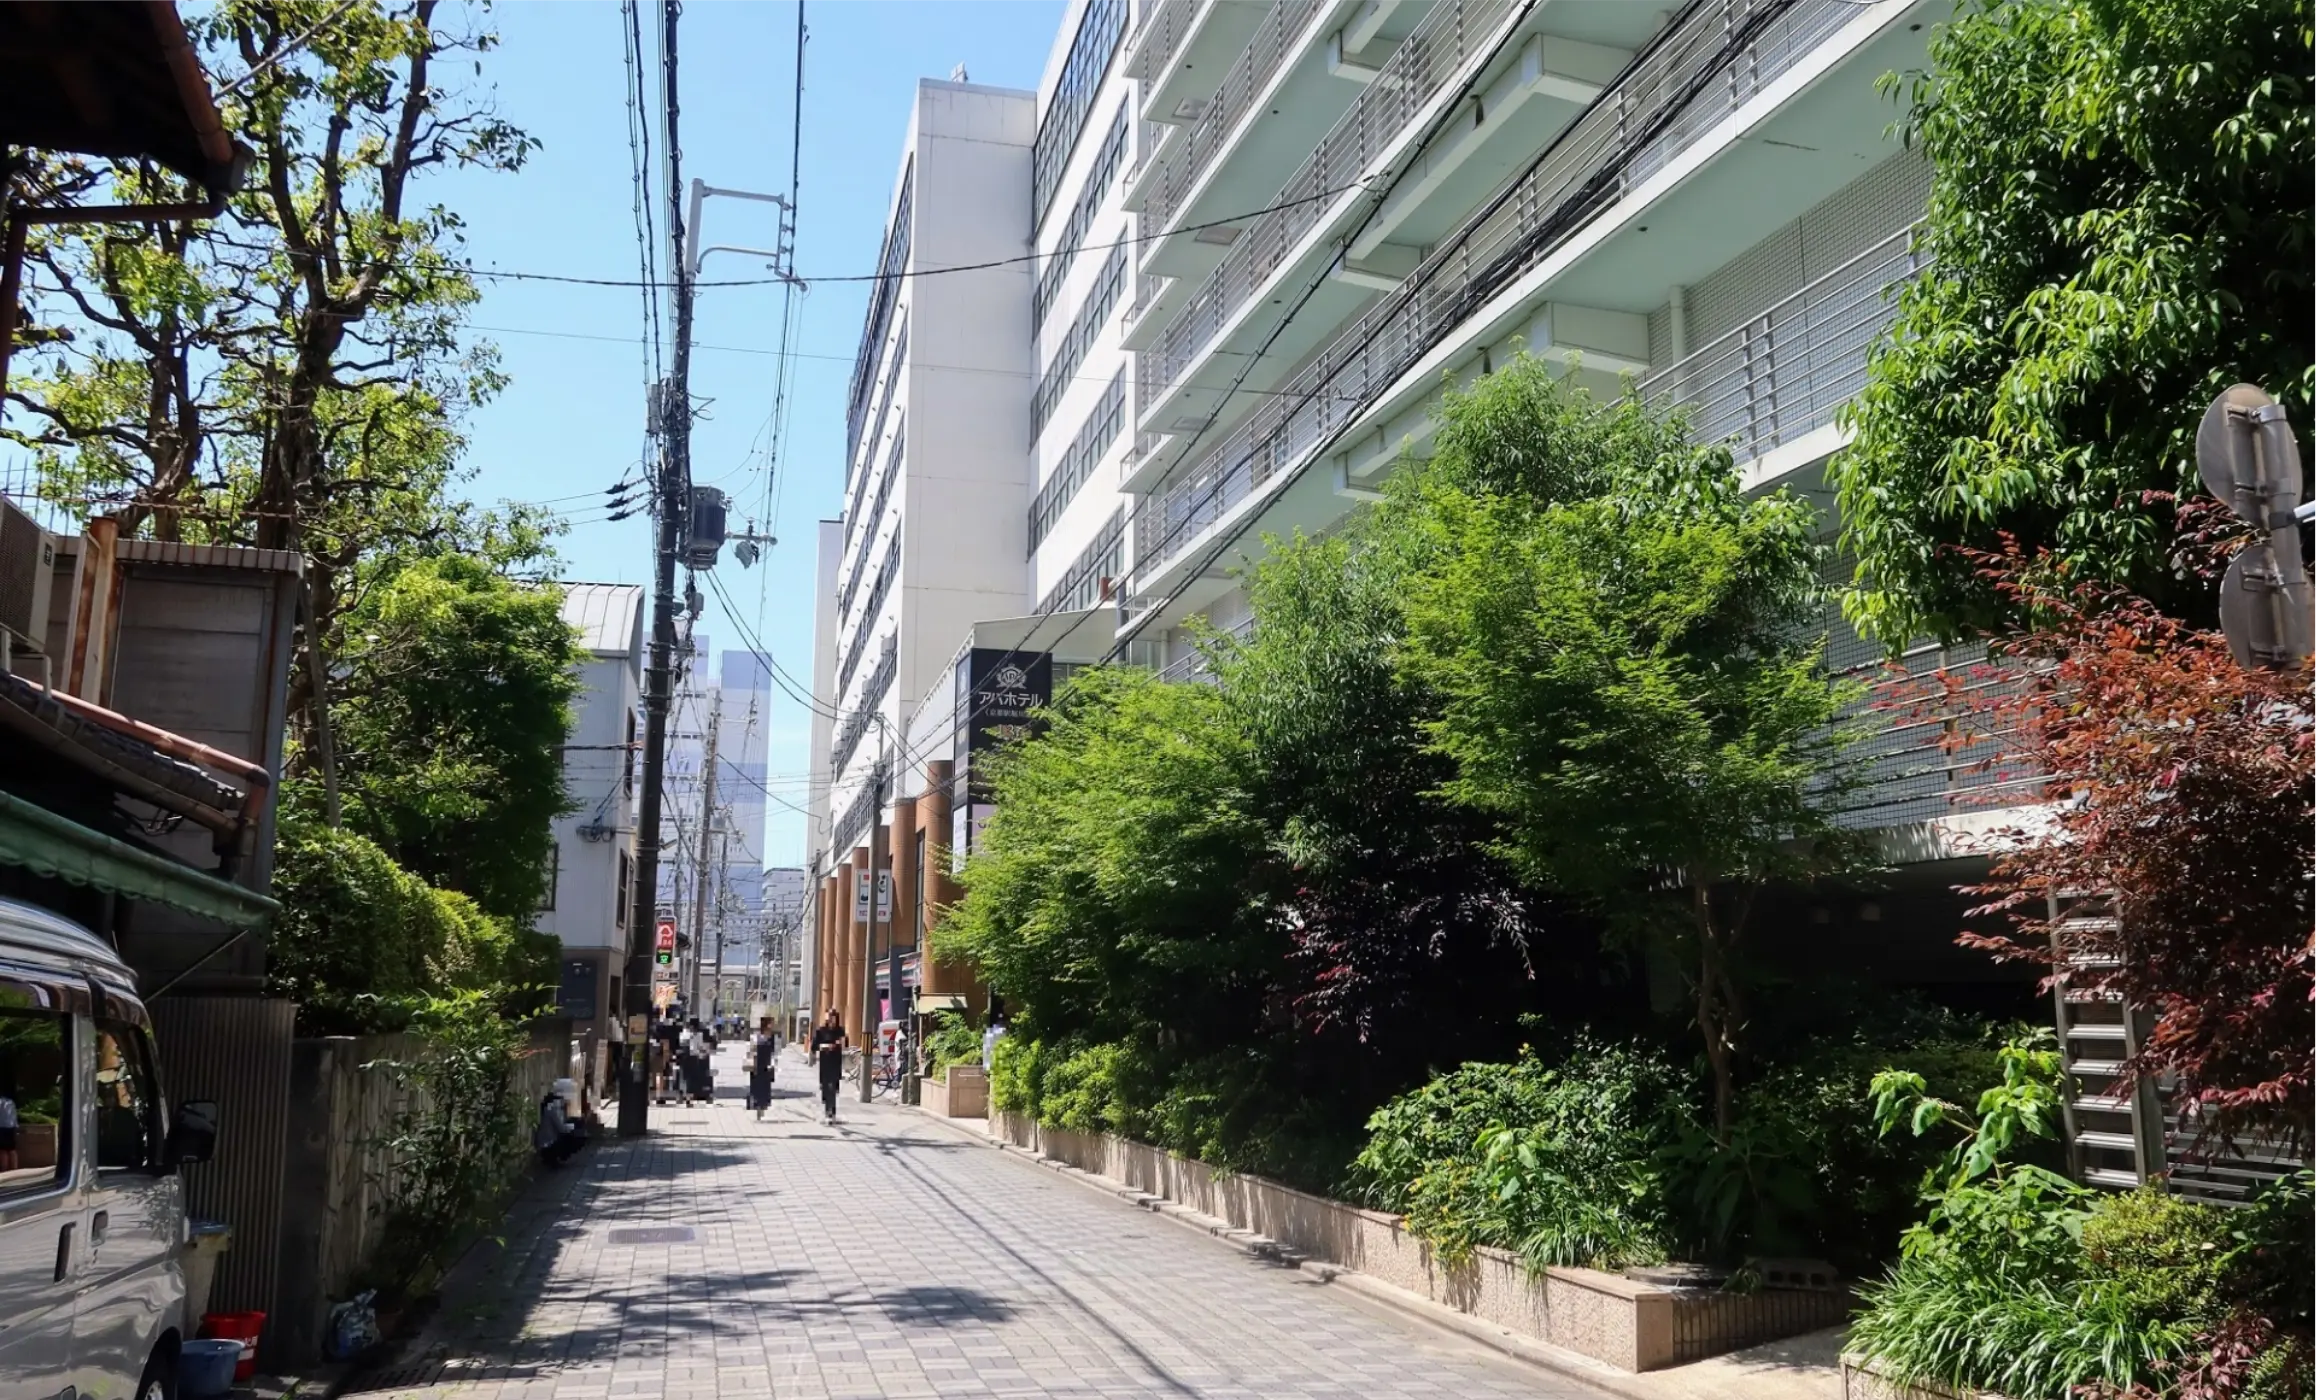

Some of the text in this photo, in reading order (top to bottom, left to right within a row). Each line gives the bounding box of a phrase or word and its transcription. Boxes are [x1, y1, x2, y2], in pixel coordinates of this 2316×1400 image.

[978, 691, 1044, 707] アパホテル
